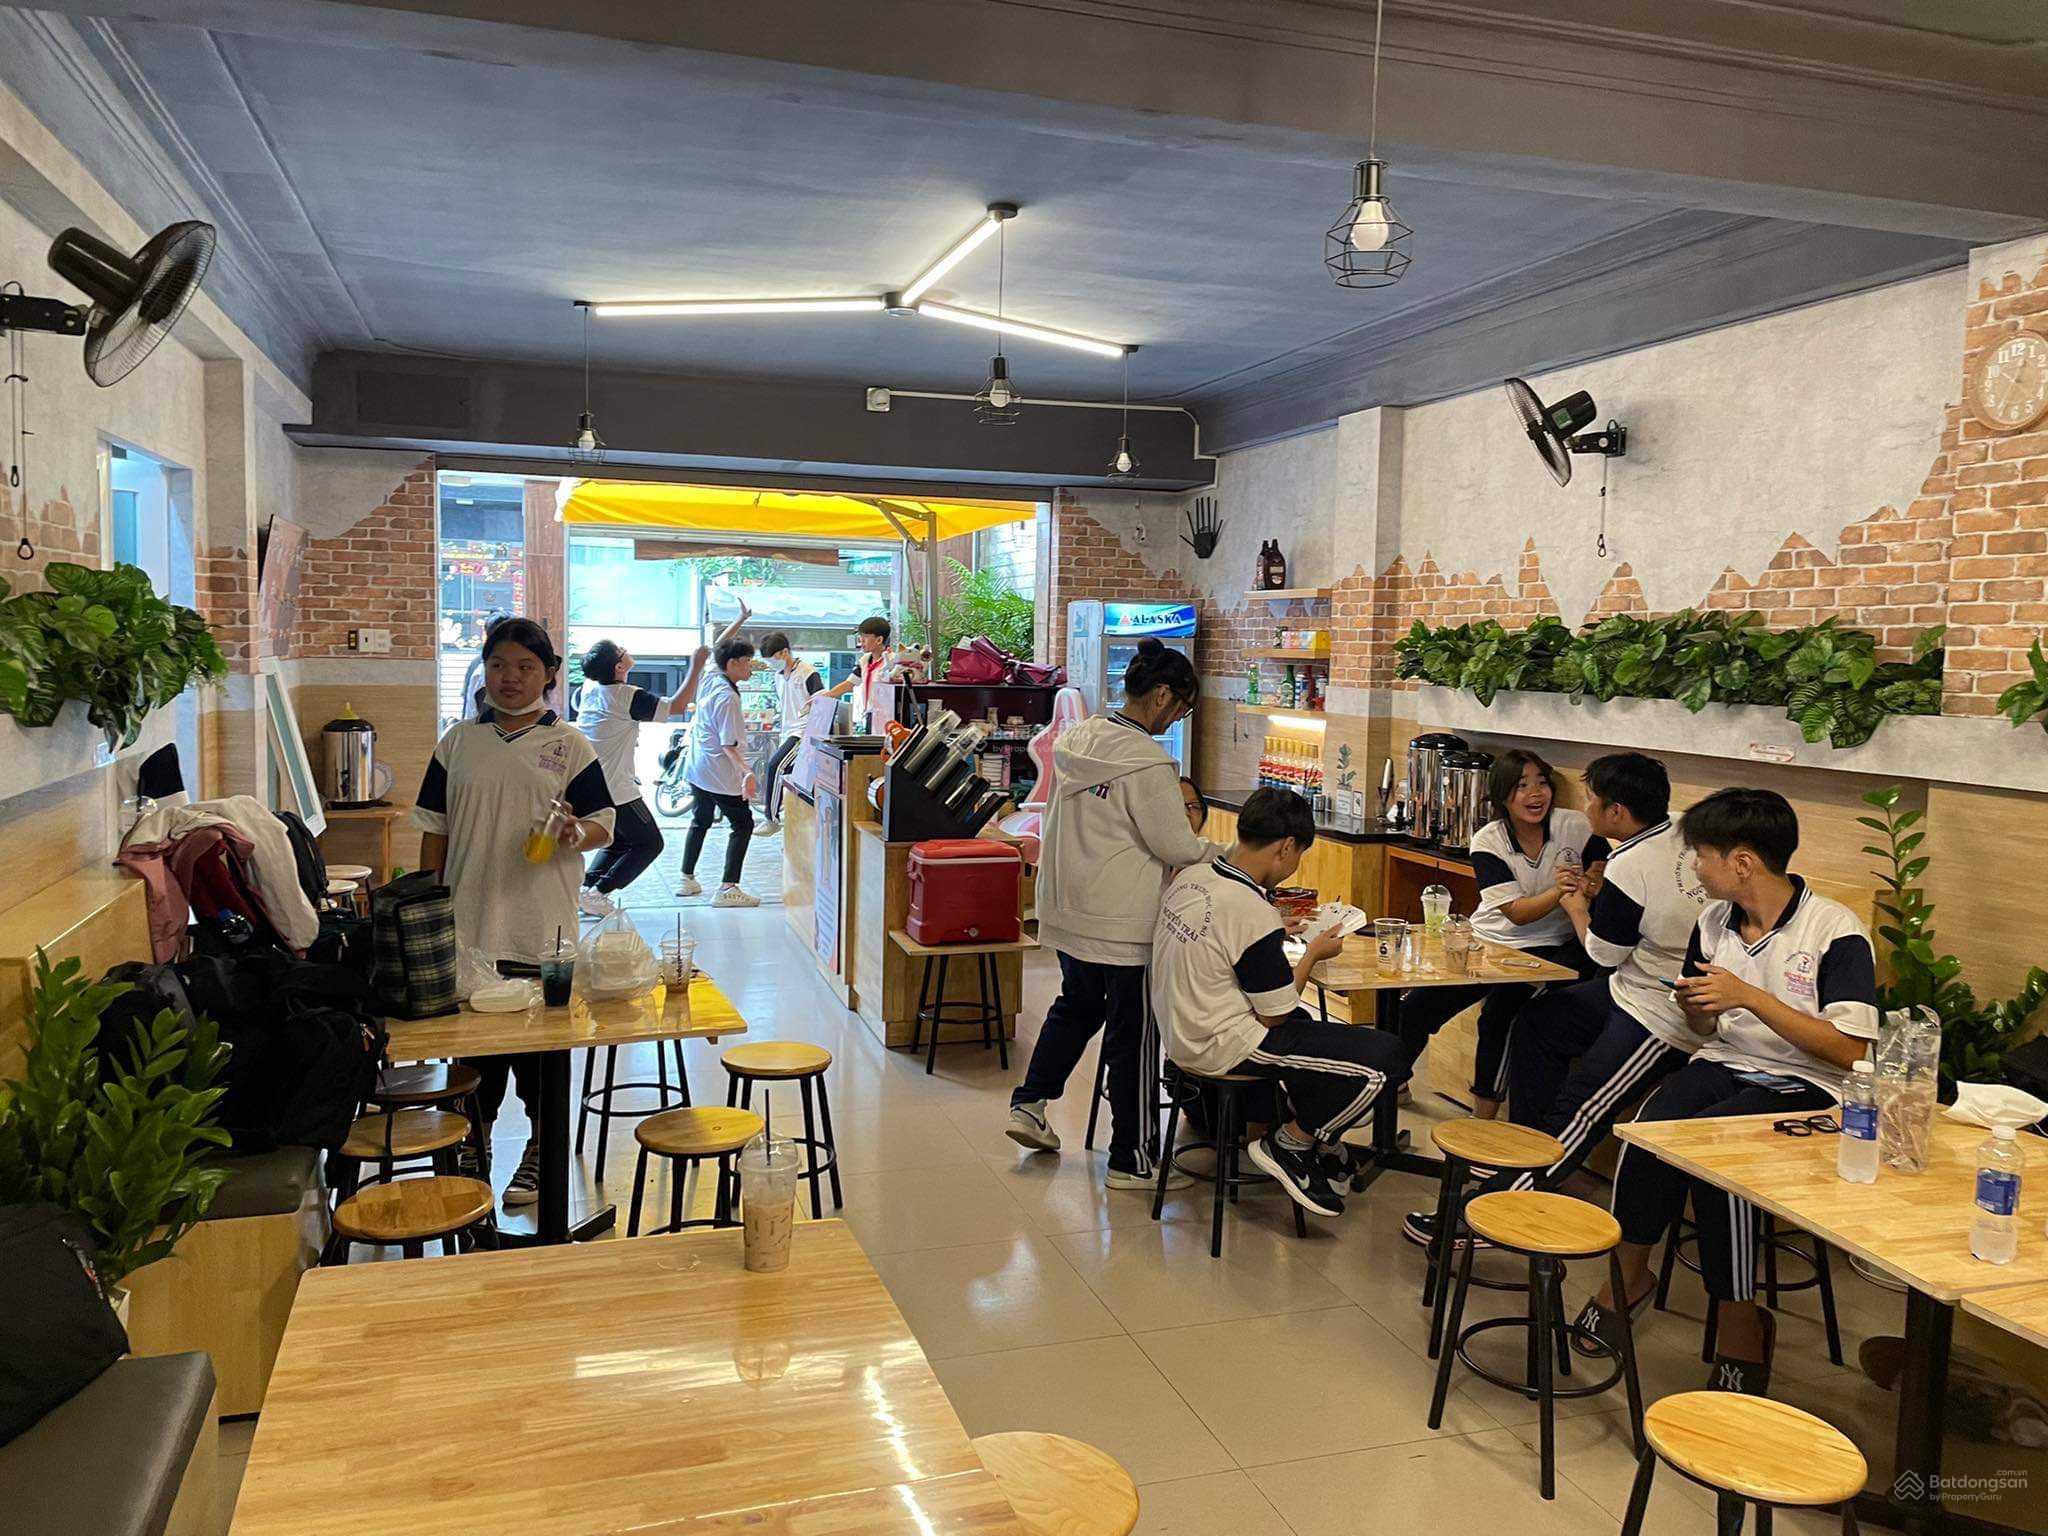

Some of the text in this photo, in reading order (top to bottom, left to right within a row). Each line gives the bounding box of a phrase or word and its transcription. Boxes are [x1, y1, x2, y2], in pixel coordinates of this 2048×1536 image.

[2011, 342, 2026, 357] 12
[1998, 350, 2009, 364] 11
[1986, 365, 2000, 380] 10
[1131, 612, 1182, 625] ALASKA
